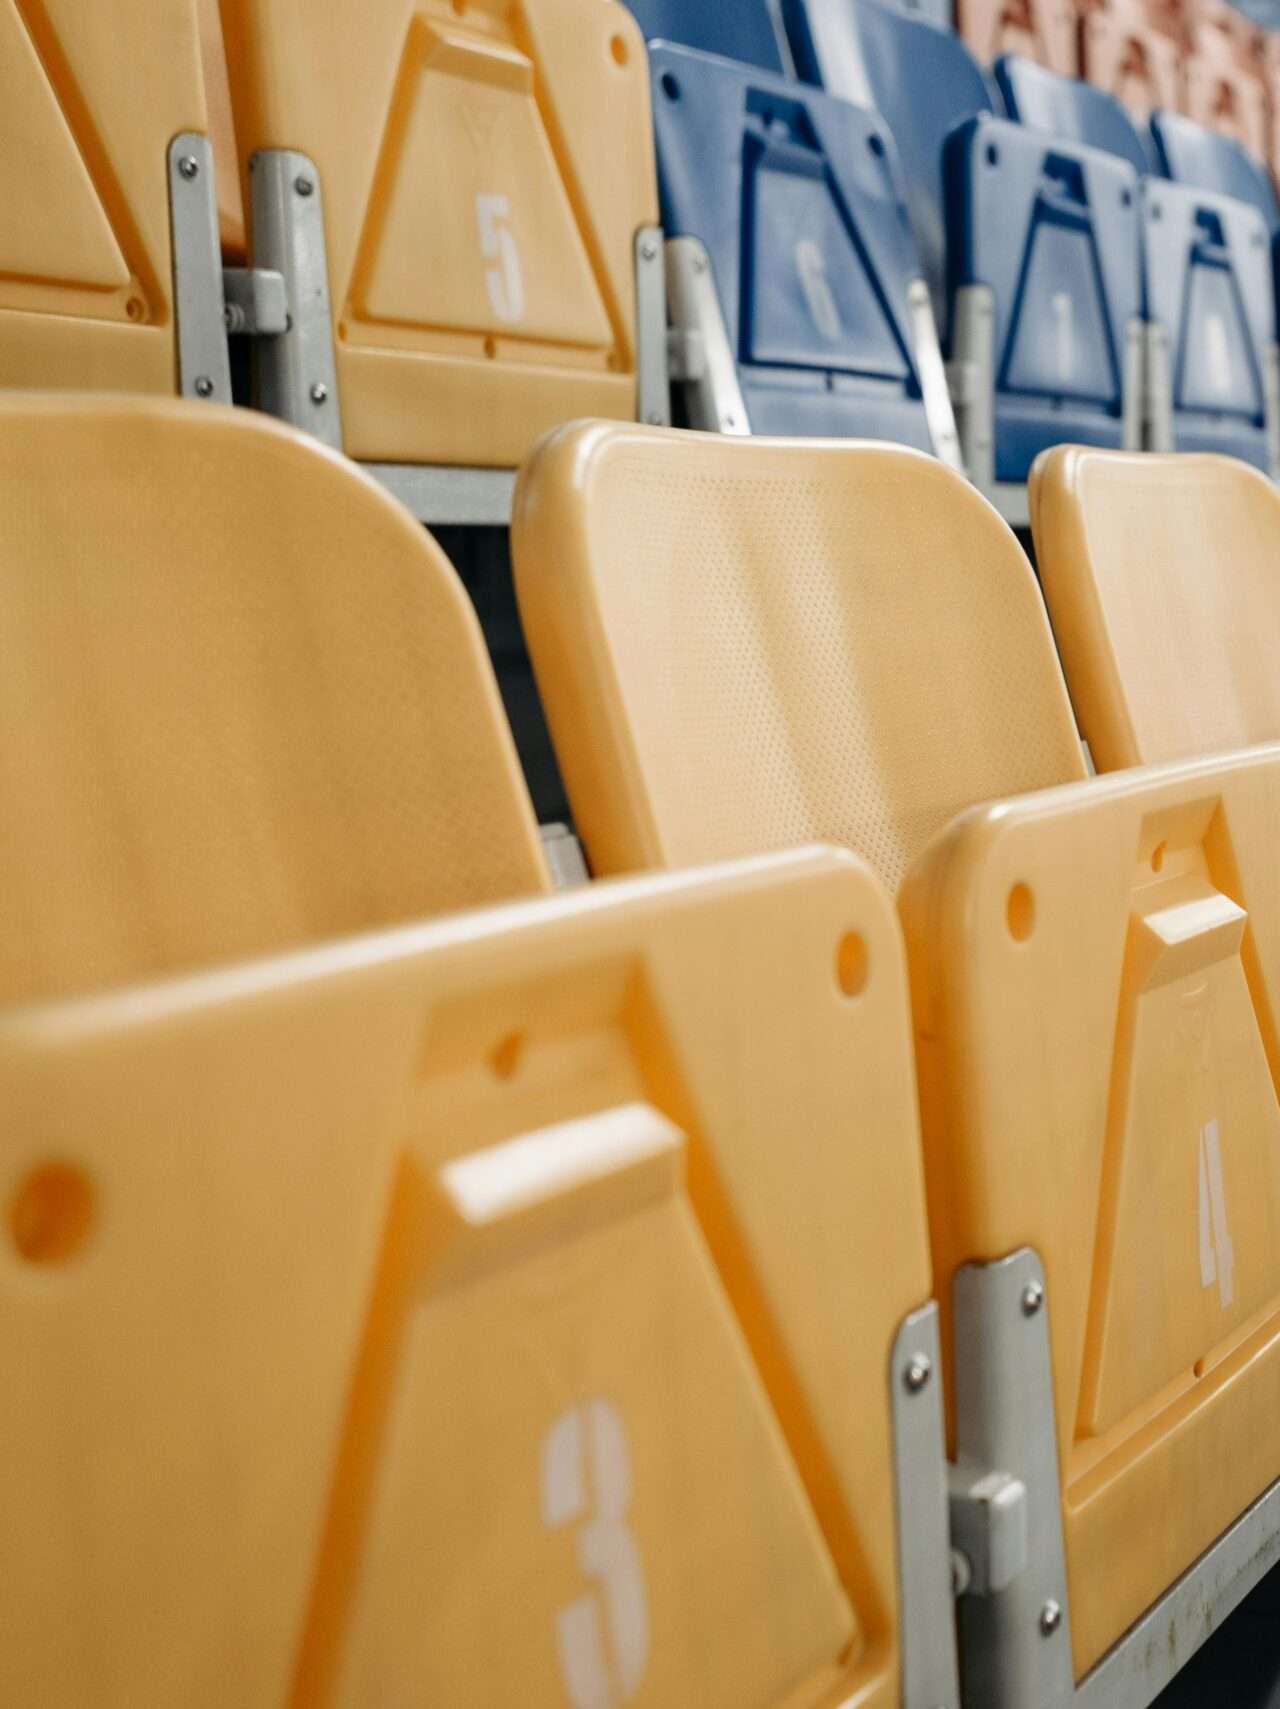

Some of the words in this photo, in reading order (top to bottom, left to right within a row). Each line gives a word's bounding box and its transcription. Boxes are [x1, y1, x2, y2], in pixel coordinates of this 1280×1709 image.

[473, 192, 526, 323] 5
[1199, 1119, 1233, 1310] 4
[540, 1395, 649, 1709] 3
